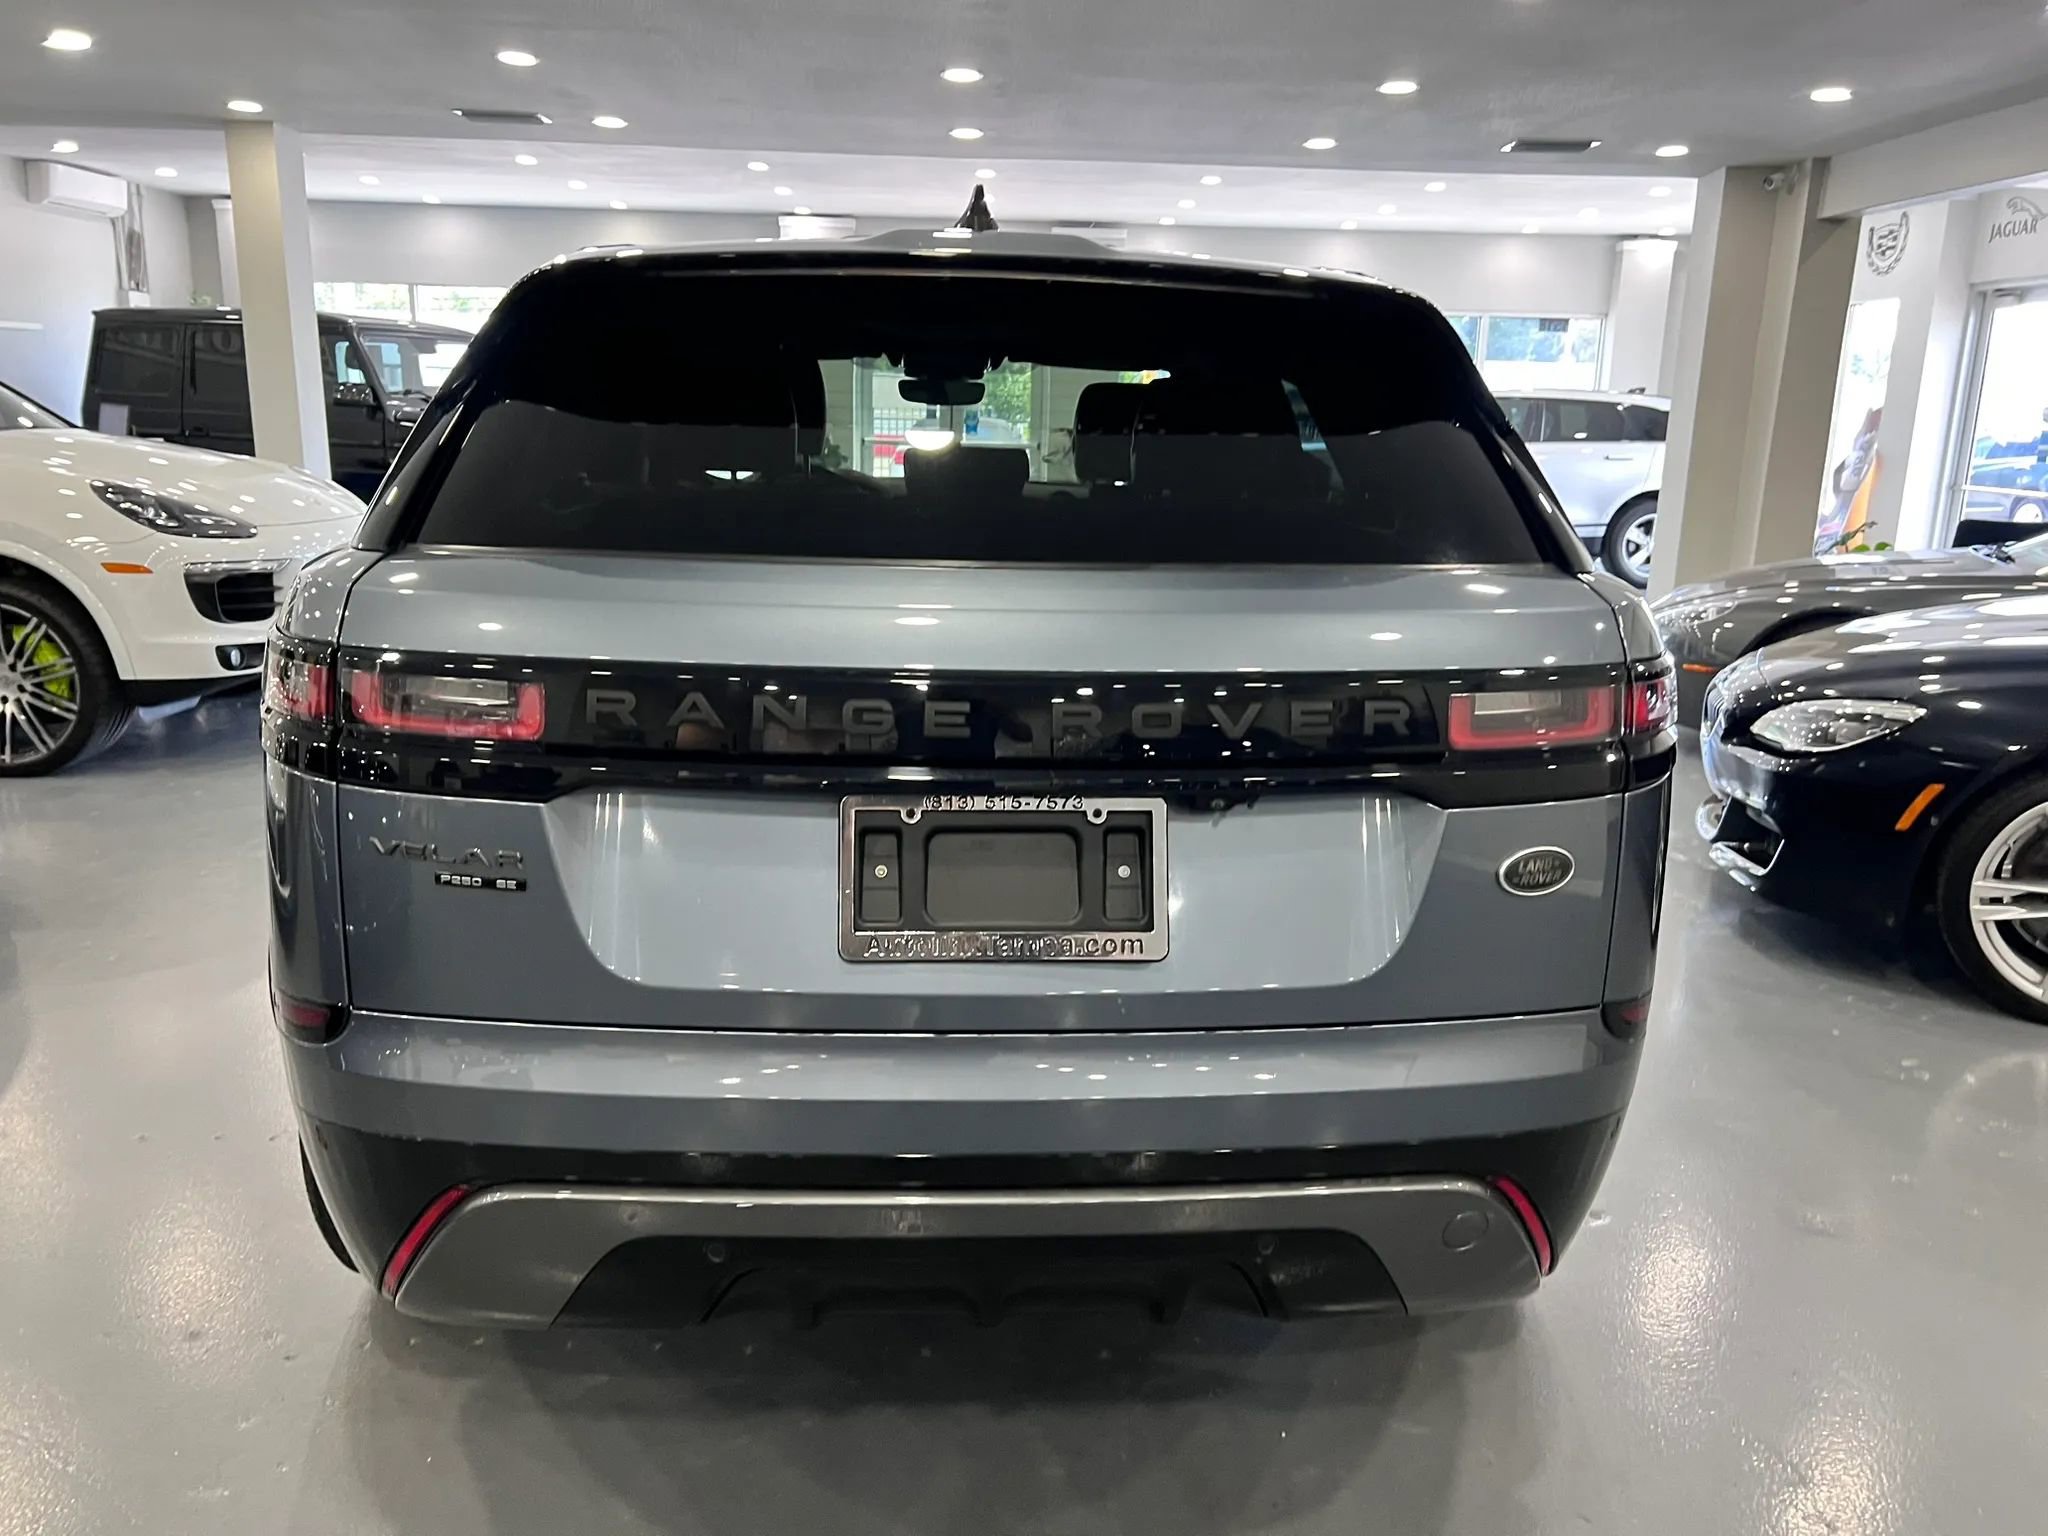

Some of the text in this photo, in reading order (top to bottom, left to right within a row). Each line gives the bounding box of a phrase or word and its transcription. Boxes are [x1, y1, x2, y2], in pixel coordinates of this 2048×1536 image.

[1988, 218, 2039, 243] JAGUAR
[586, 689, 1411, 739] RANGE ROVER
[923, 794, 1084, 811] (813) 515-7573
[369, 836, 524, 870] VELAR
[1518, 857, 1553, 874] LAND
[440, 874, 482, 887] P250
[1519, 868, 1562, 887] ROVER
